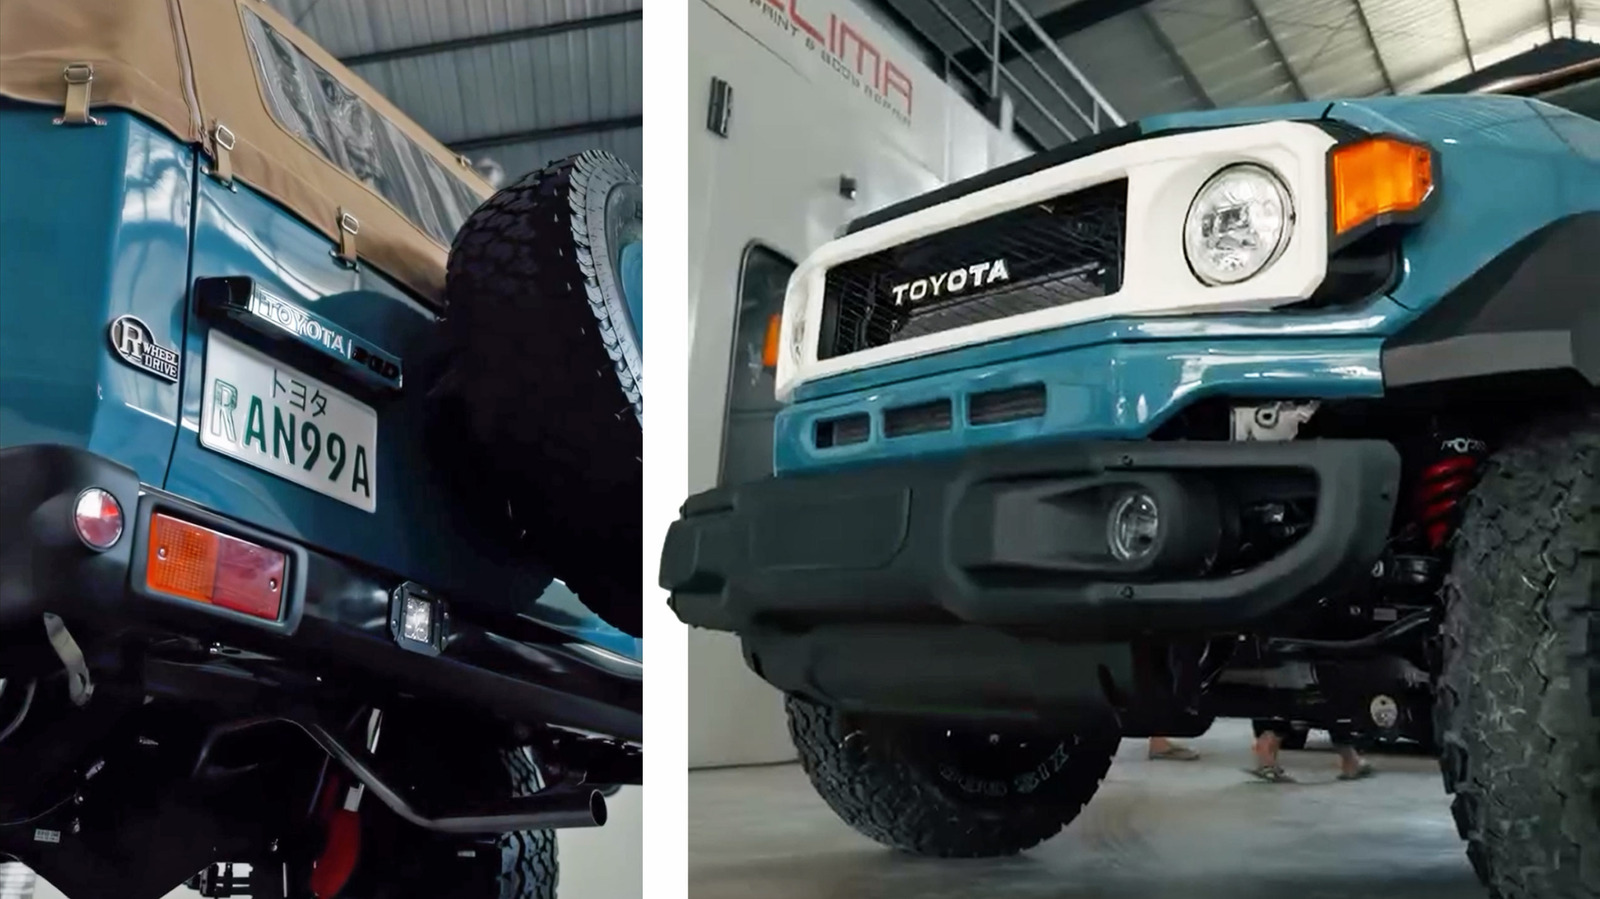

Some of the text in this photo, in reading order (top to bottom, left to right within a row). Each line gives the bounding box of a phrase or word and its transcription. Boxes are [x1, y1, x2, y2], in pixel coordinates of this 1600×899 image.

[892, 258, 1009, 306] TOYOTA
[264, 296, 346, 357] TOYOTA
[142, 341, 178, 366] WHEEL
[144, 354, 178, 378] DRIVE
[270, 368, 328, 417] トヨタ
[210, 378, 371, 498] RAN99A
